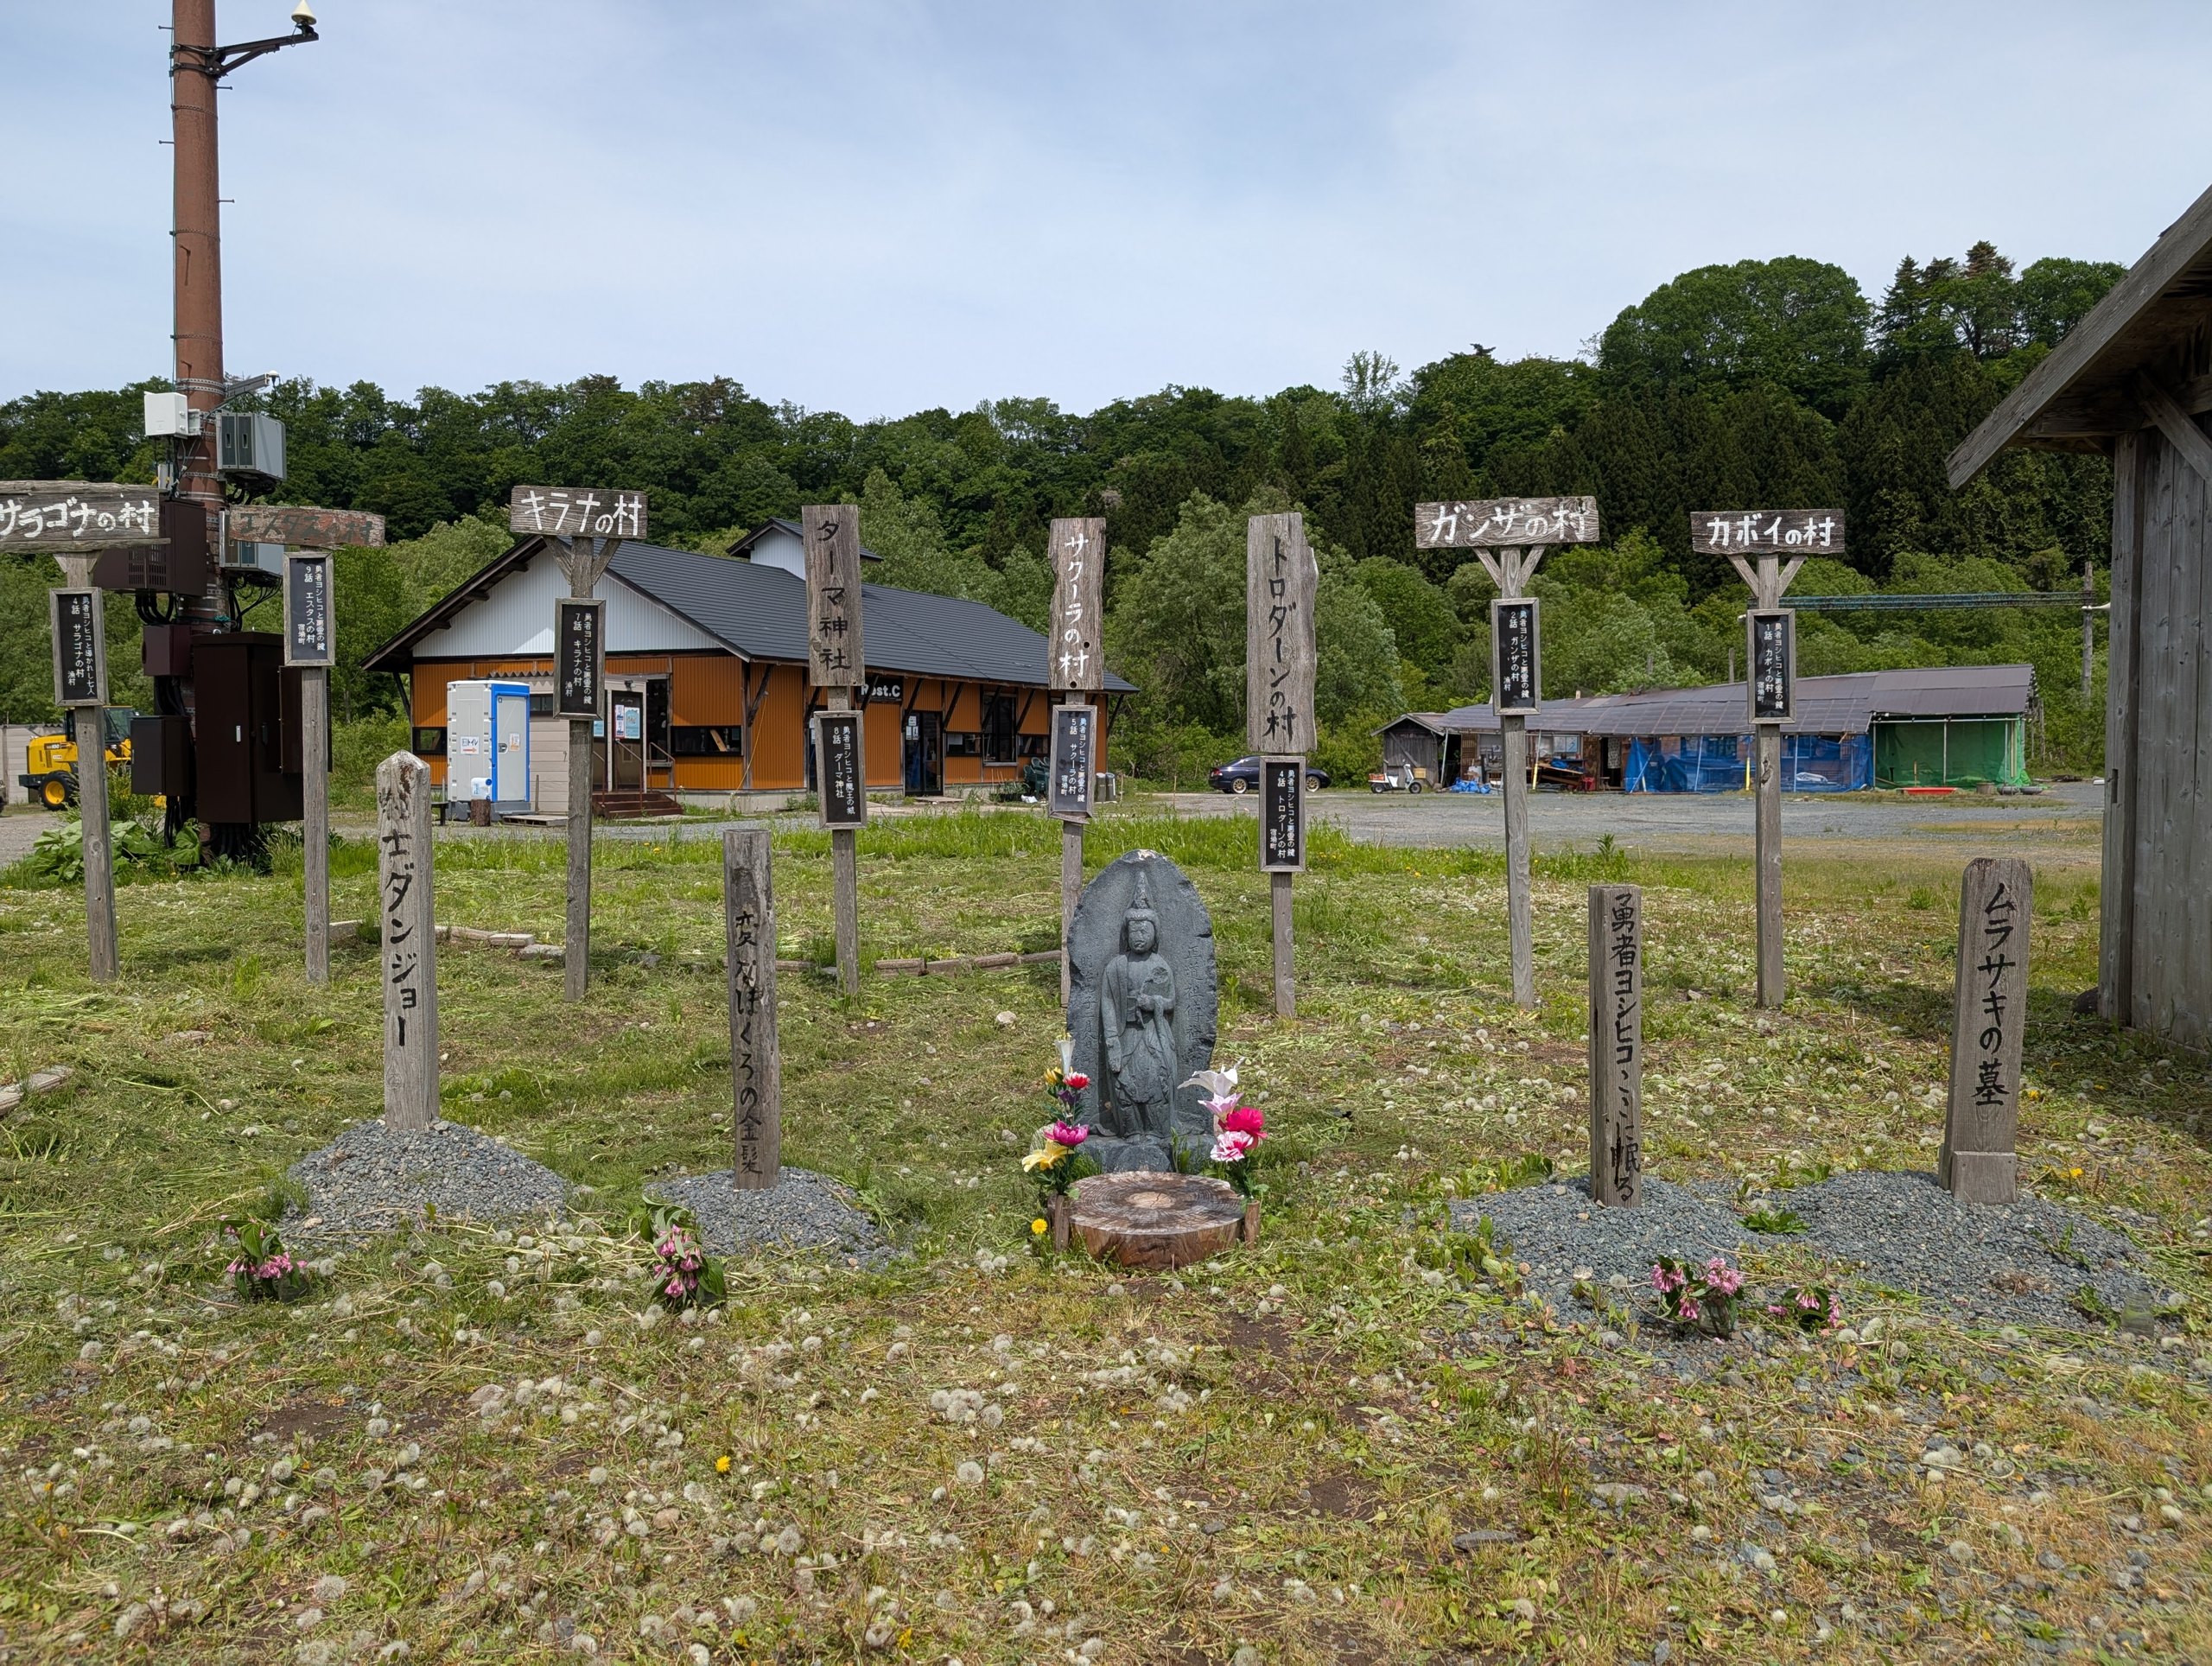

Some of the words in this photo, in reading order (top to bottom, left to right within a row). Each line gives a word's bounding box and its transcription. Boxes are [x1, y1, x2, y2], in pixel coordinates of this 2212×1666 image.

[0, 496, 156, 538] サラゴナの村
[521, 490, 643, 537] キラナの村
[1430, 502, 1591, 544] ガンザの村
[1707, 512, 1835, 547] カボイの村
[305, 592, 315, 644] エスタスの村
[1058, 532, 1090, 679] サクーラの村
[73, 624, 85, 678] サラゴナの村
[1262, 535, 1297, 744] トロダーンの村
[1510, 637, 1520, 682] ガンザの村
[573, 640, 582, 687] キラナの村
[1764, 649, 1774, 693] カボイの村
[834, 754, 844, 798] ダーマ神社
[1068, 743, 1077, 795] サクーラの村
[1277, 795, 1287, 859] トロダーンの村
[1971, 882, 2017, 1107] ムラサキの墓
